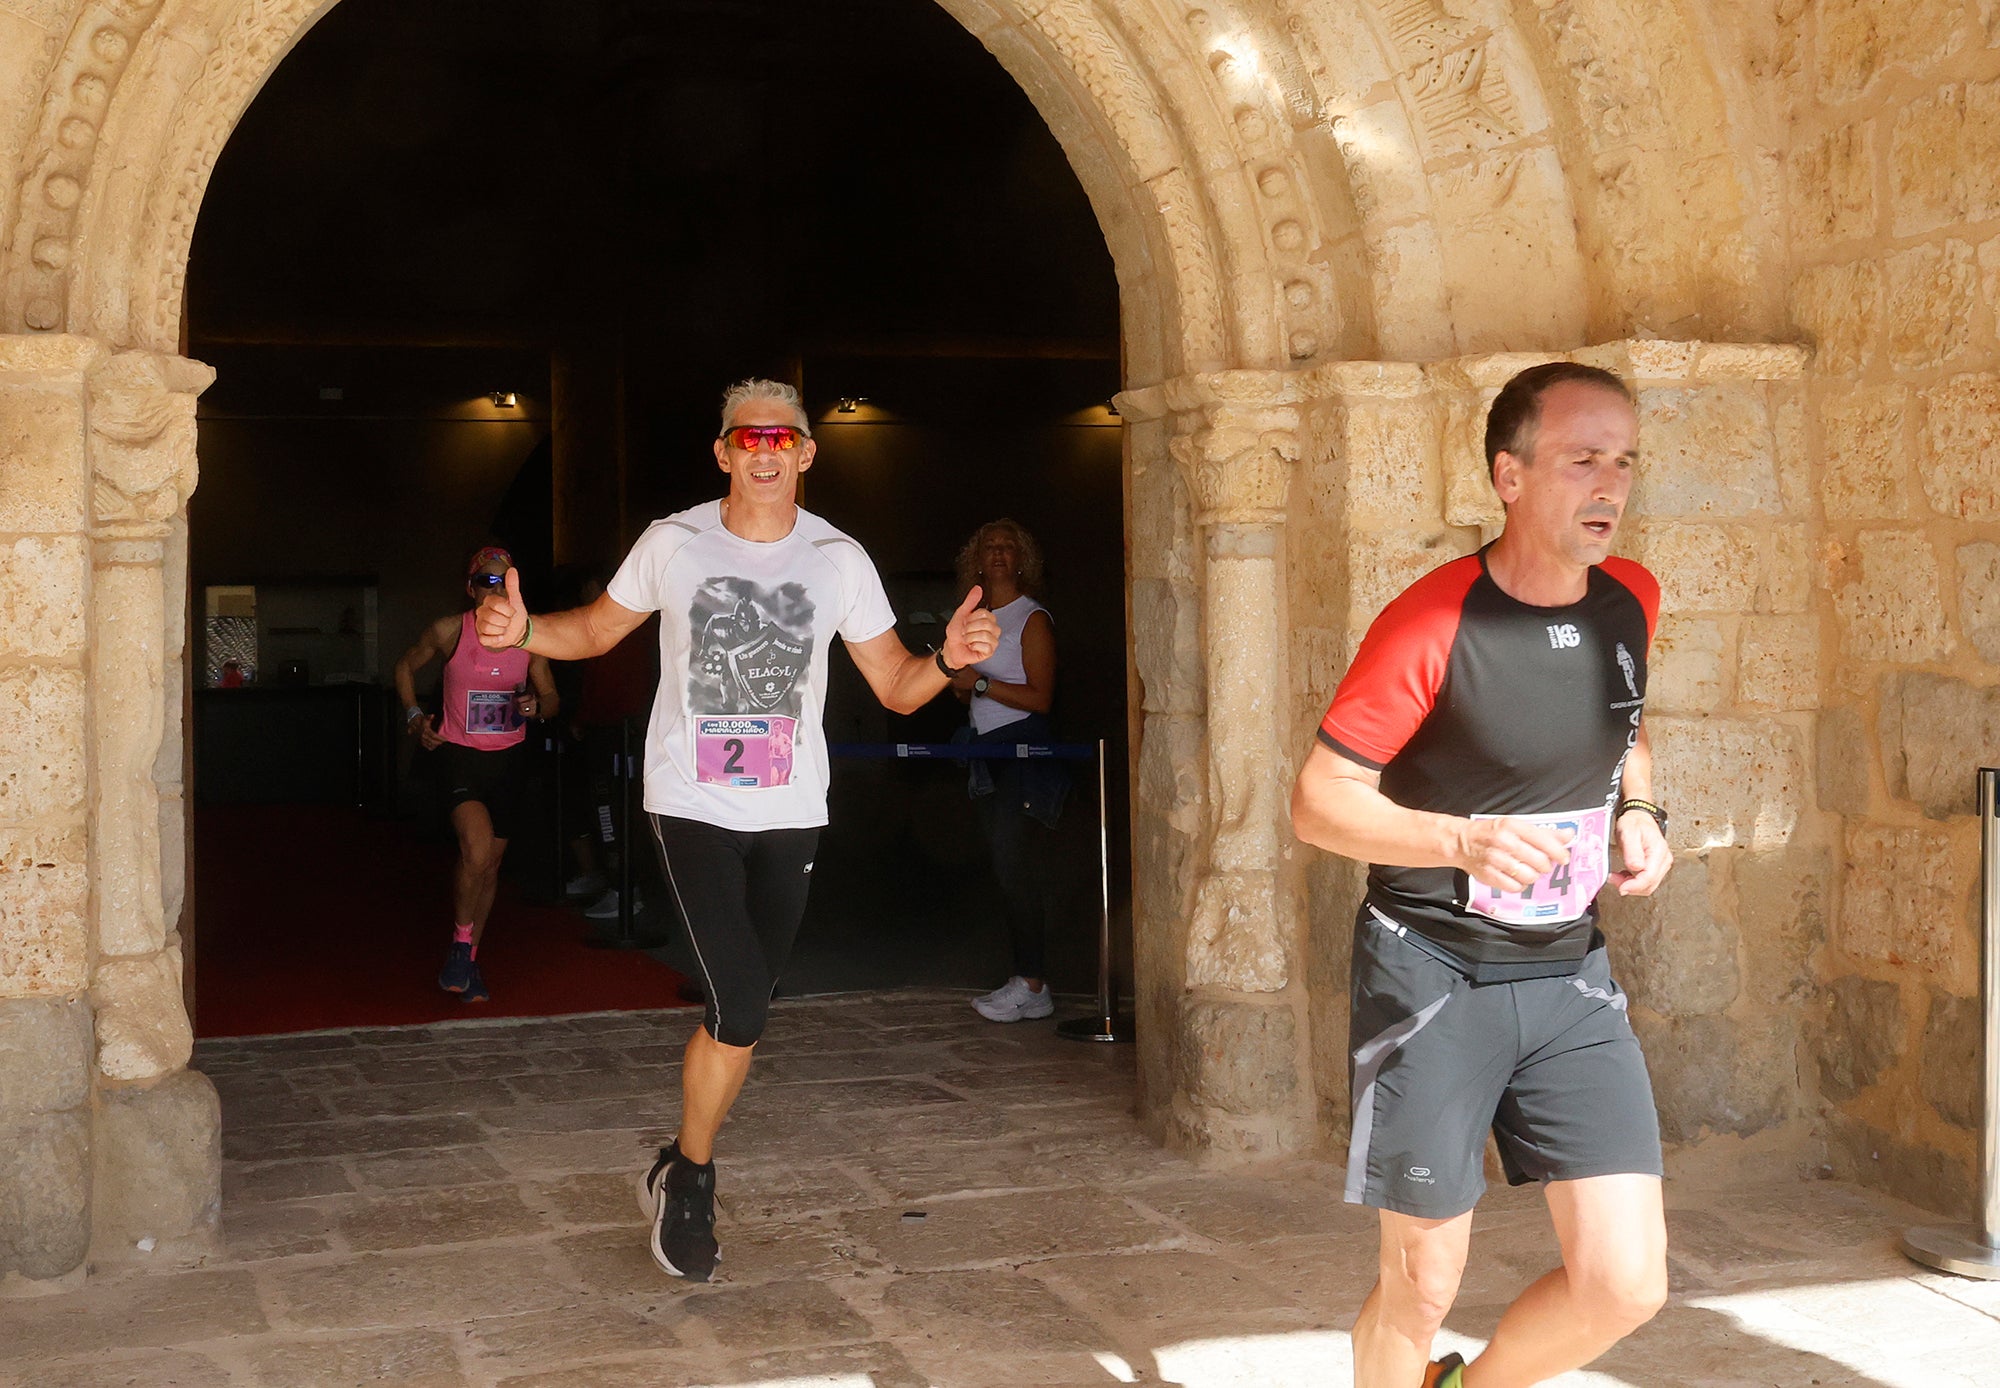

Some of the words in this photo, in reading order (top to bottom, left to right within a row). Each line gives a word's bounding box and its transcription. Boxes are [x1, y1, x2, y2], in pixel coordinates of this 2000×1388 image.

[748, 665, 792, 679] ELACyL
[471, 704, 507, 724] 131
[718, 720, 752, 729] 10.000
[723, 738, 744, 774] 2
